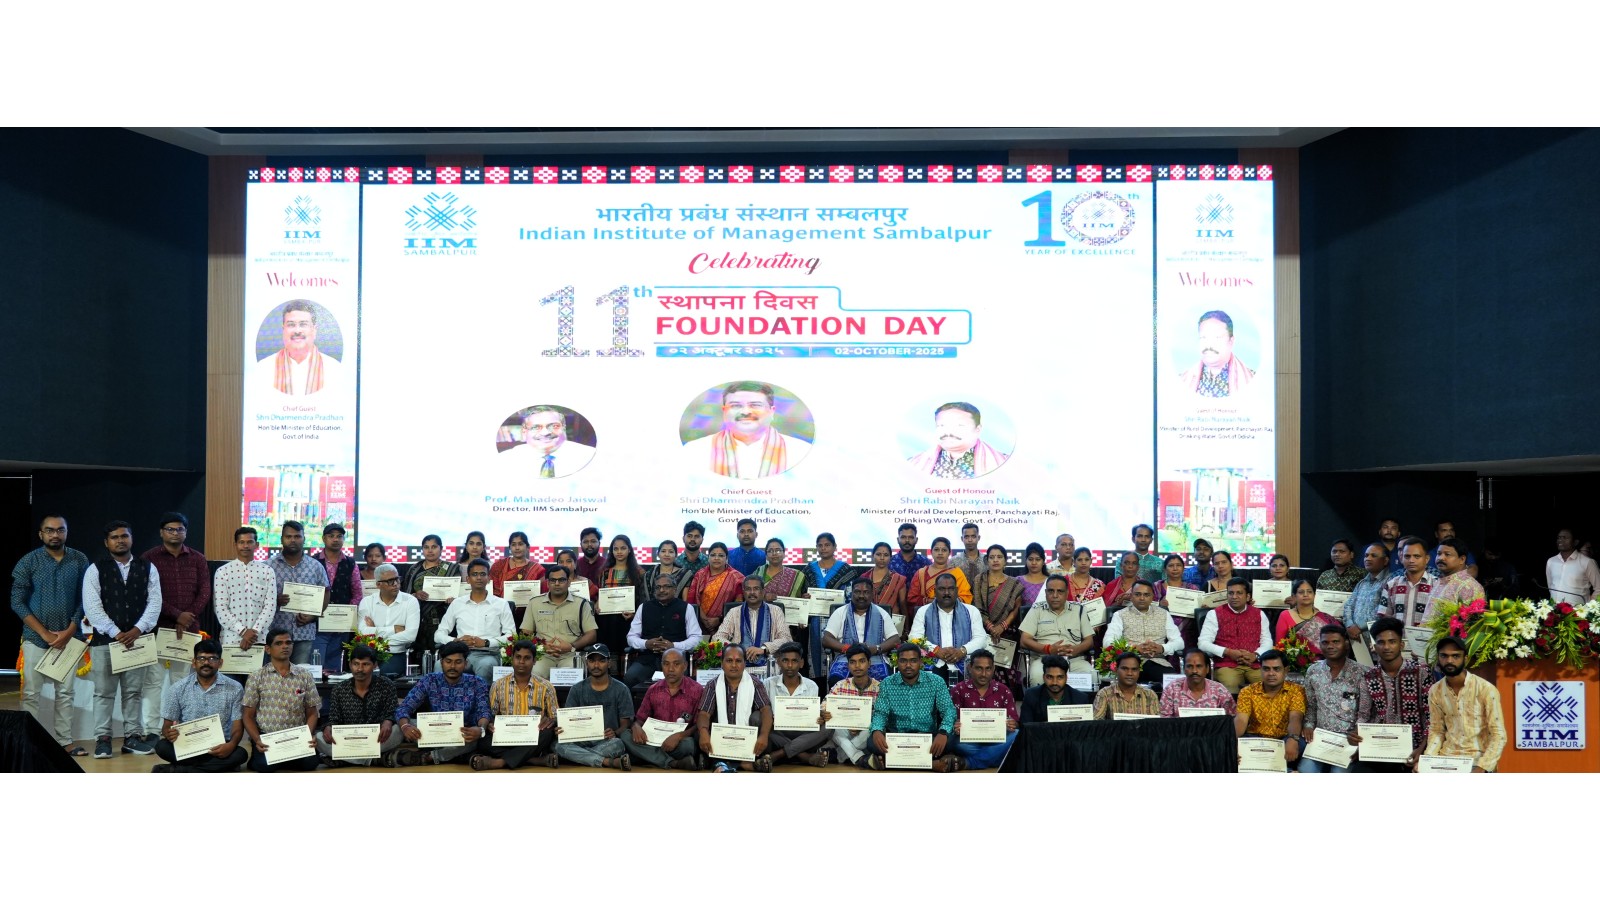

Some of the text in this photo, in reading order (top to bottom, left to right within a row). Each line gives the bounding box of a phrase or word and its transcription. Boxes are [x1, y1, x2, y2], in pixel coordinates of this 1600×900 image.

[596, 203, 909, 226] भारतीय प्रबंध संस्थान सम्बलपुर
[284, 230, 321, 239] IIM
[519, 226, 992, 243] Indian Institute of Management Sambalpur
[1196, 229, 1234, 238] IIM
[404, 238, 477, 248] IIM
[688, 252, 822, 275] Celebrating
[266, 271, 339, 287] Welcomes
[1178, 271, 1253, 287] Welcomes
[657, 290, 819, 311] स्थापना दिवस
[656, 316, 947, 335] FOUNDATION DAY
[834, 347, 945, 356] 02-OCTOBER-2025
[924, 487, 951, 495] Guest
[951, 487, 962, 495] of
[485, 495, 607, 503] Prof. Mahadeo Jaiswal
[900, 496, 1020, 506] Shri Rabi Narayan Naik
[492, 505, 531, 513] Director,
[549, 505, 598, 513] Sambalpur
[765, 507, 812, 515] Education,
[932, 508, 993, 517] Development,
[995, 508, 1043, 517] Panchayati
[754, 516, 776, 524] India
[894, 517, 932, 525] Drinking
[1522, 730, 1579, 740] IIM
